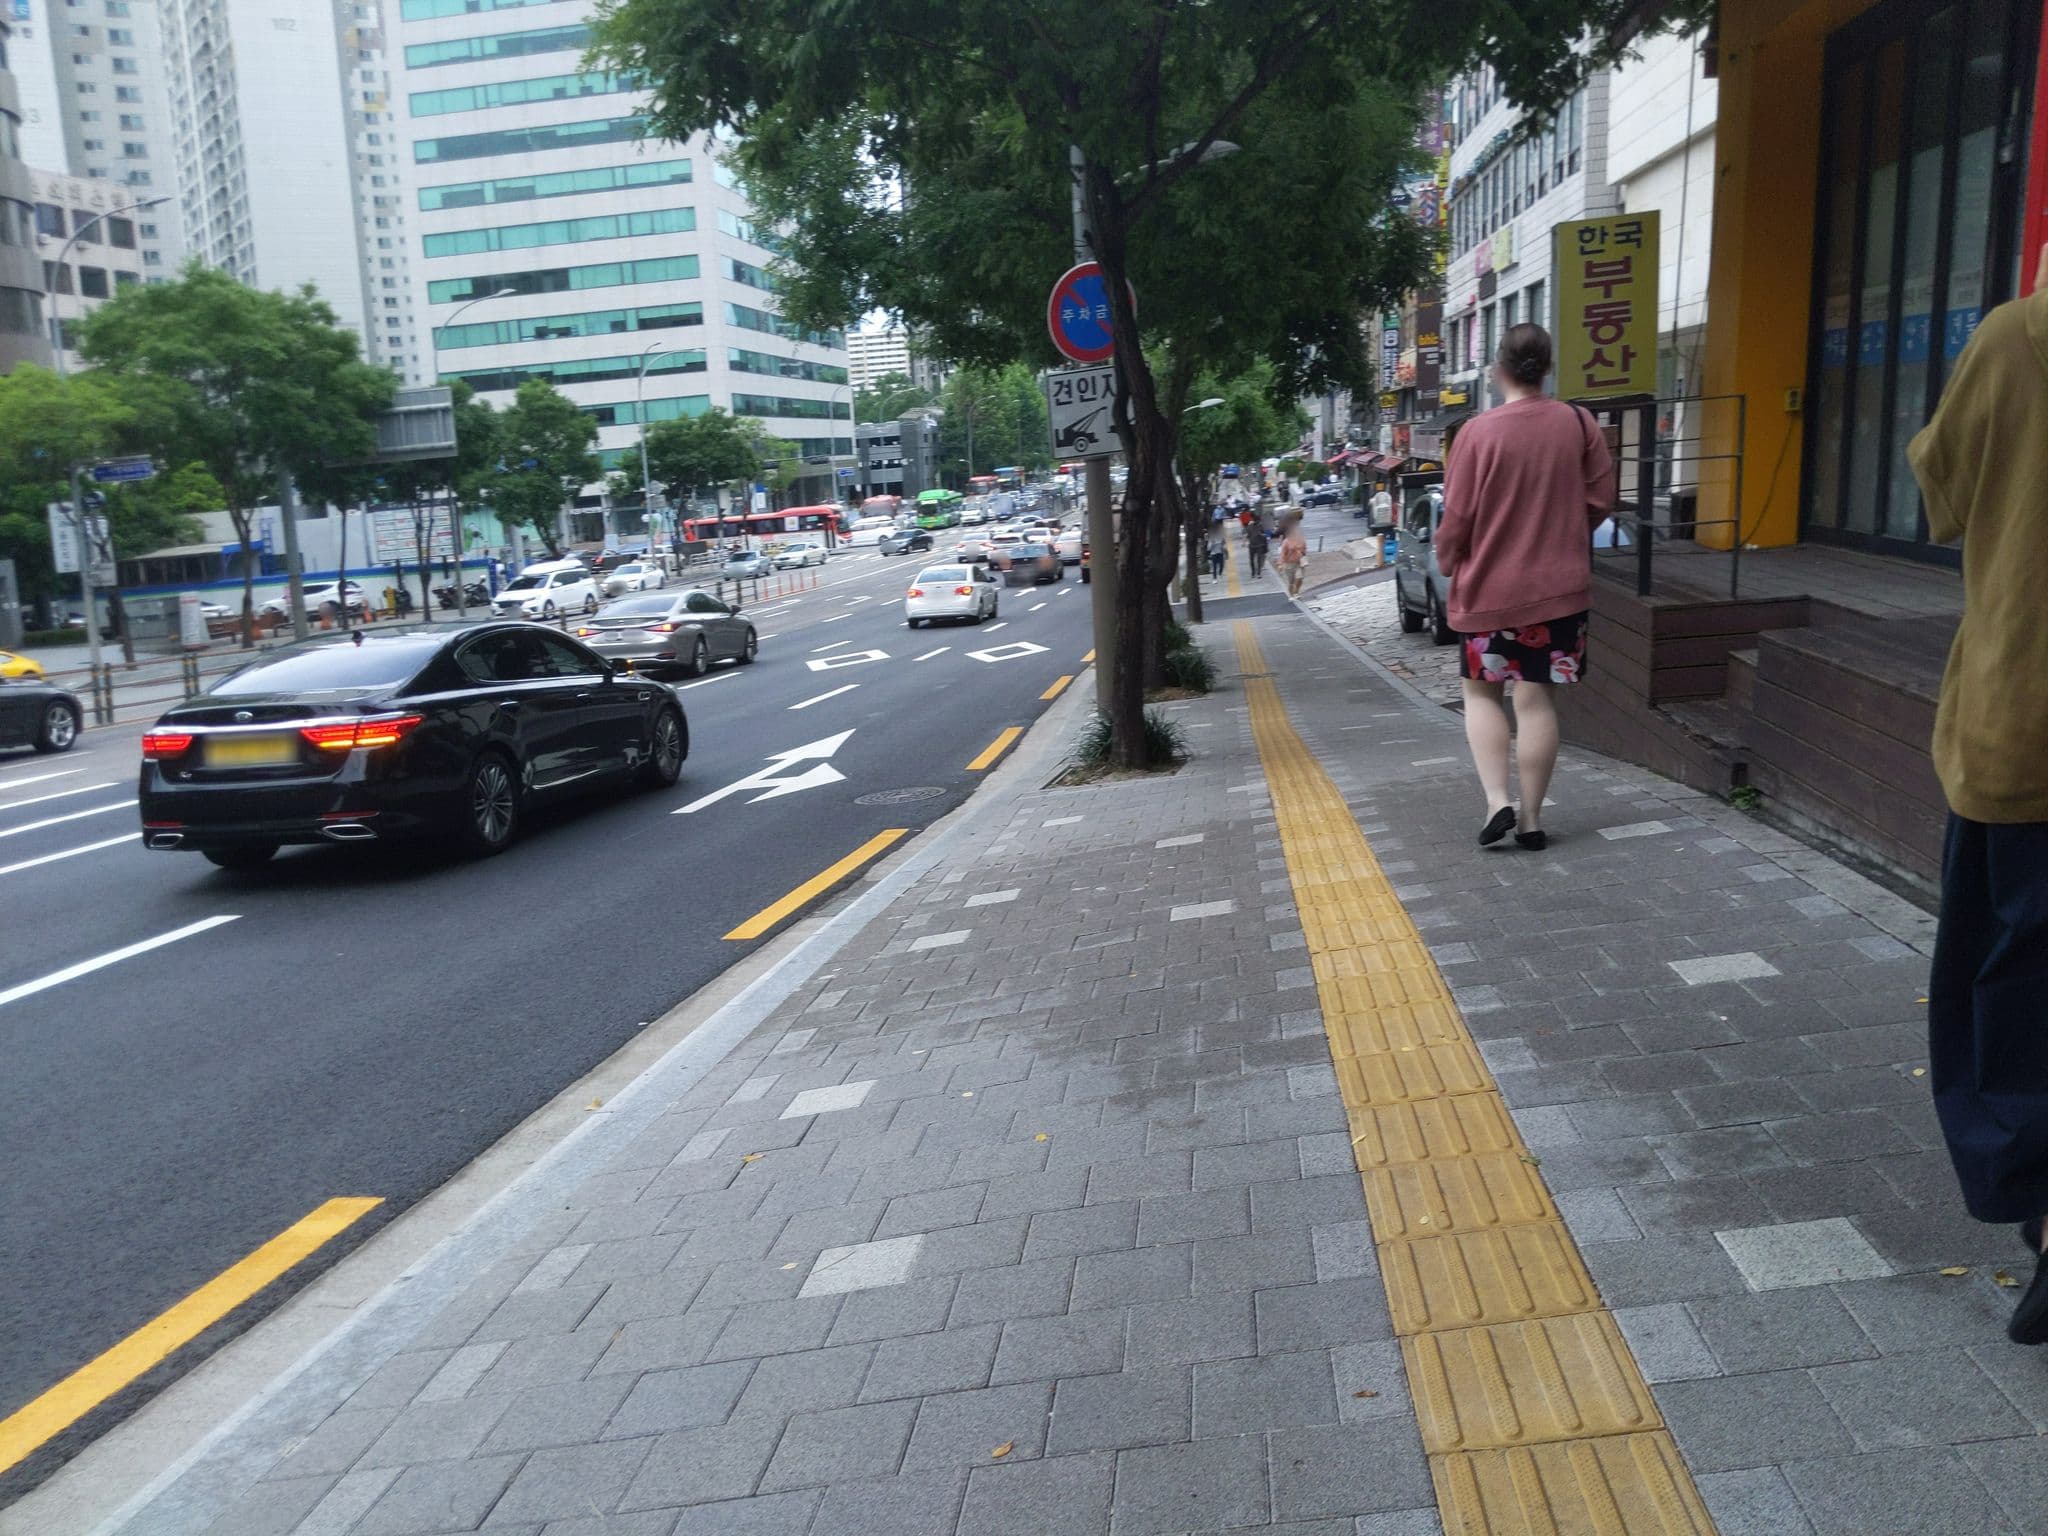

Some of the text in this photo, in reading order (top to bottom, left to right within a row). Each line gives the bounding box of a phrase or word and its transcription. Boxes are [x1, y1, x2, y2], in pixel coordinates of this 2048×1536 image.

[1577, 221, 1644, 256] 한국
[1061, 304, 1110, 321] 주차금
[1582, 257, 1637, 388] 부동산
